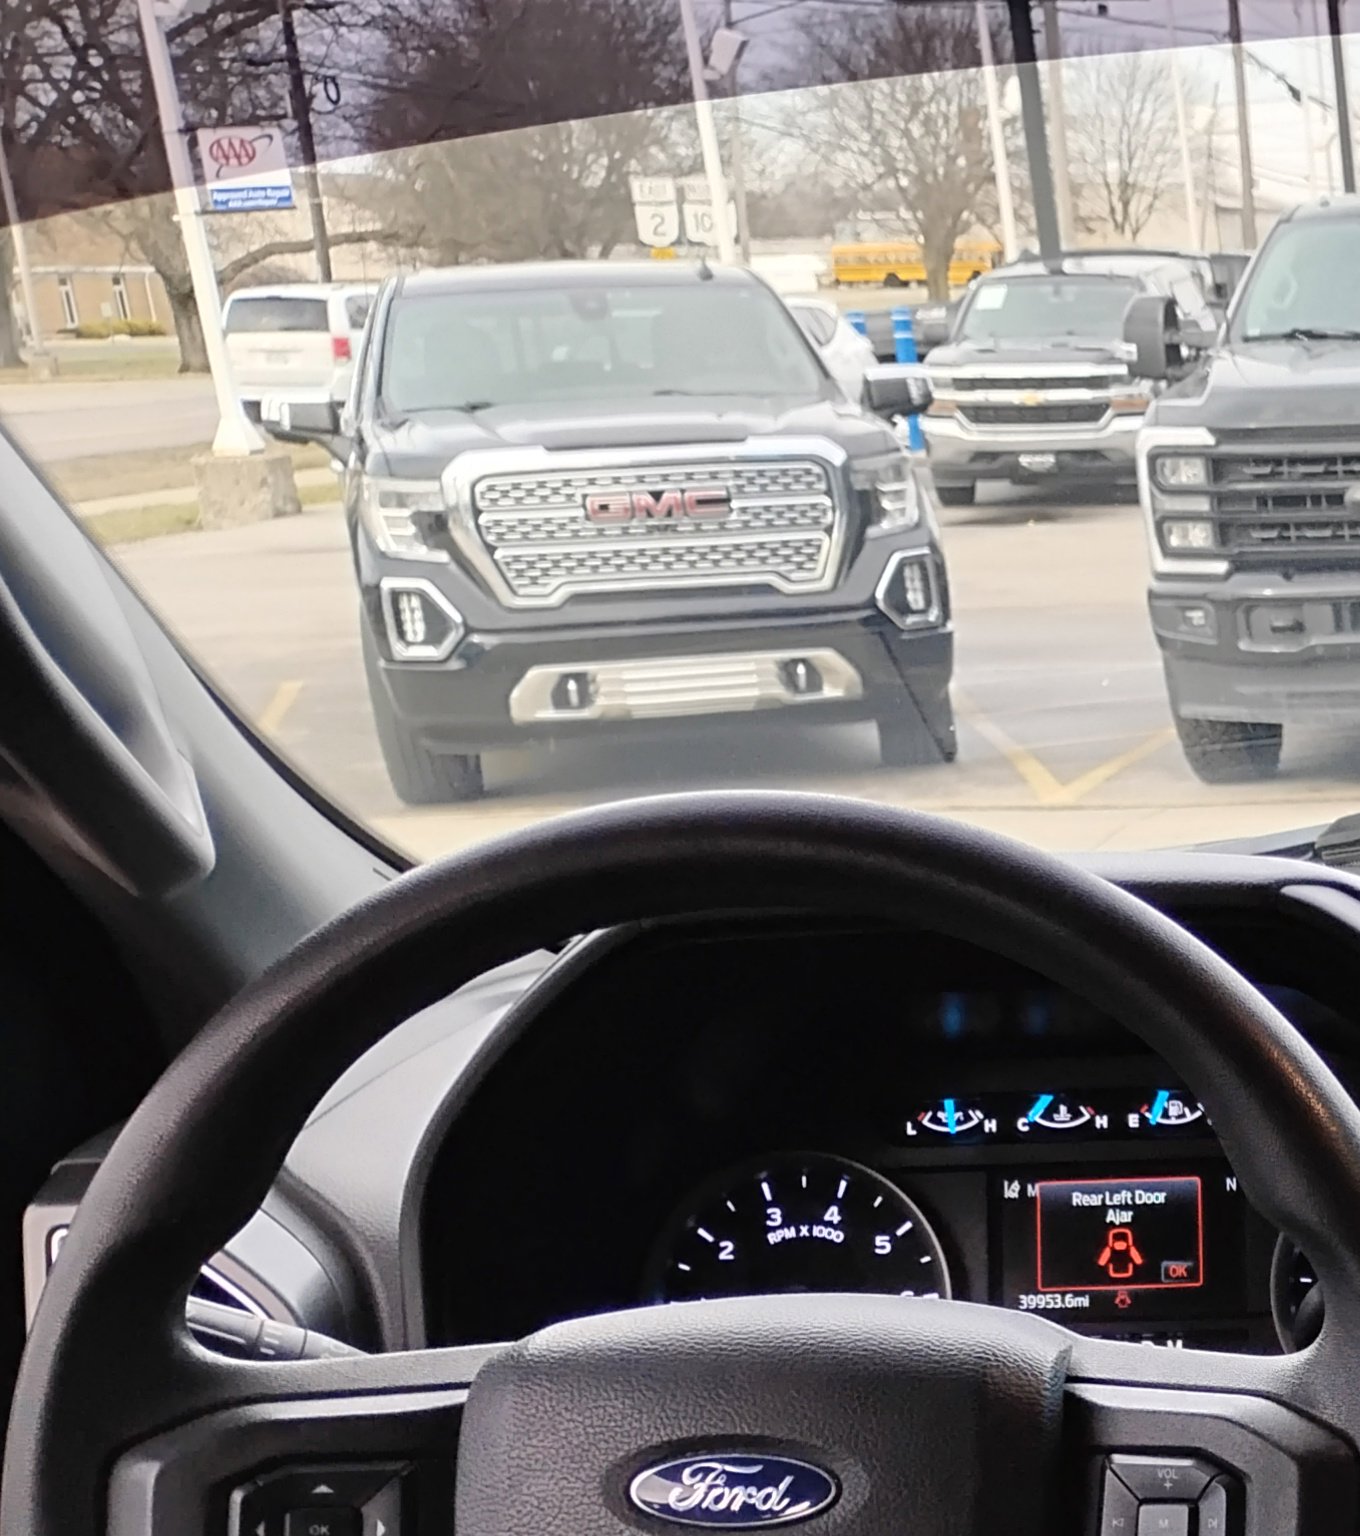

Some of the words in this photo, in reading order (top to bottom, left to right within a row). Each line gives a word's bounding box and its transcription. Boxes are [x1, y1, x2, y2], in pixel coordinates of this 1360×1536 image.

[210, 136, 256, 168] AAA
[650, 212, 667, 237] 2
[694, 211, 714, 233] 10
[586, 487, 732, 522] GMC
[906, 1120, 918, 1136] L
[984, 1119, 998, 1134] H
[1017, 1118, 1031, 1132] C
[1095, 1116, 1109, 1130] H
[1128, 1113, 1140, 1128] E
[1226, 1177, 1238, 1192] N
[1072, 1191, 1103, 1206] Rear
[1105, 1190, 1133, 1205] Left
[1135, 1189, 1167, 1204] Door
[766, 1207, 783, 1226] 3
[823, 1205, 842, 1225] 4
[1105, 1209, 1134, 1225] Ajar
[766, 1226, 797, 1245] RPM
[799, 1226, 810, 1238] X
[812, 1225, 845, 1244] 1000
[718, 1241, 735, 1260] 2
[874, 1235, 892, 1255] 5
[1169, 1265, 1188, 1278] OK
[1018, 1294, 1090, 1310] 39953.6mi
[1156, 1467, 1179, 1479] VOL
[668, 1461, 795, 1514] Ford
[308, 1523, 331, 1536] OK
[1158, 1518, 1169, 1529] M
